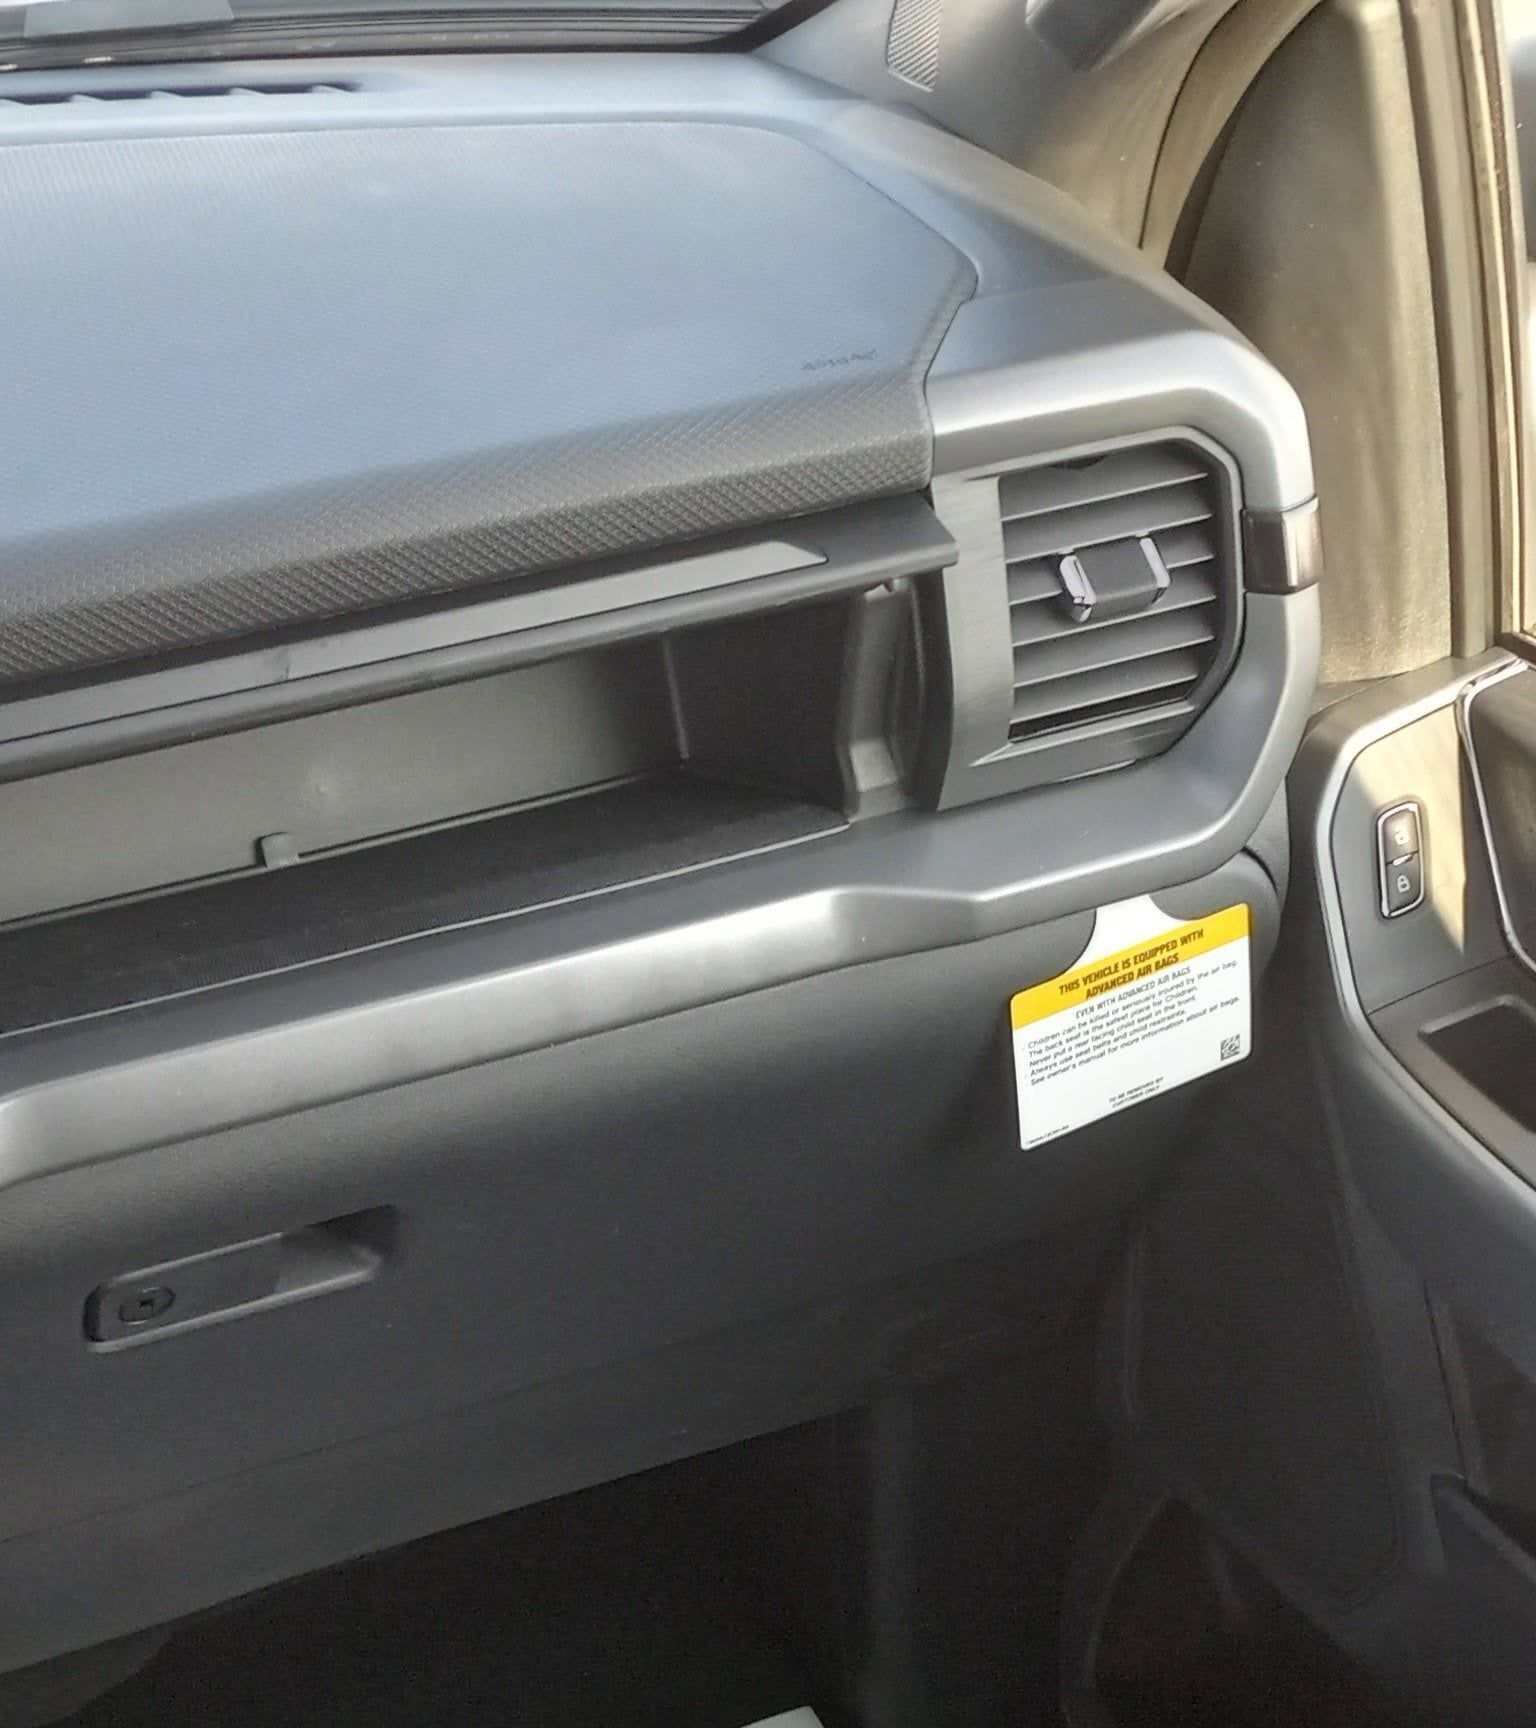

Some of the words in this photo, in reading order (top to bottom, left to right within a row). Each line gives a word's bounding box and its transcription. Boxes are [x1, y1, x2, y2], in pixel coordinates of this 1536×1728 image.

[1058, 978, 1080, 995] THIS
[1082, 962, 1119, 986] VEHICLE
[1121, 958, 1131, 970] IS
[1133, 939, 1177, 965] EQUIPPED
[1179, 928, 1203, 946] WITH
[1086, 971, 1134, 999] ADVANCED
[1136, 964, 1152, 979] AIR
[1154, 952, 1179, 971] BAGS
[1097, 997, 1115, 1010] WITH
[1117, 980, 1155, 1002] ADVANCED
[1157, 974, 1169, 985] AIR
[1171, 966, 1191, 980] BAGS
[1028, 1032, 1060, 1049] Children
[1062, 1025, 1076, 1035] can
[1089, 1010, 1109, 1024] killed
[1158, 980, 1184, 996] injured
[1028, 1048, 1043, 1057] The
[1045, 1040, 1063, 1051] back
[1065, 1032, 1081, 1043] seat
[1091, 1023, 1103, 1032] the
[1130, 1004, 1150, 1018] place
[1029, 1054, 1051, 1067] Never
[1053, 1047, 1066, 1059] put
[1091, 1028, 1114, 1042] facing
[1116, 1019, 1135, 1032] child
[1136, 1012, 1152, 1023] seat
[1163, 1003, 1175, 1012] the
[1030, 1062, 1057, 1077] Always
[1059, 1055, 1073, 1065] use
[1113, 1032, 1127, 1043] and
[1129, 1023, 1147, 1036] child
[1031, 1076, 1045, 1086] See
